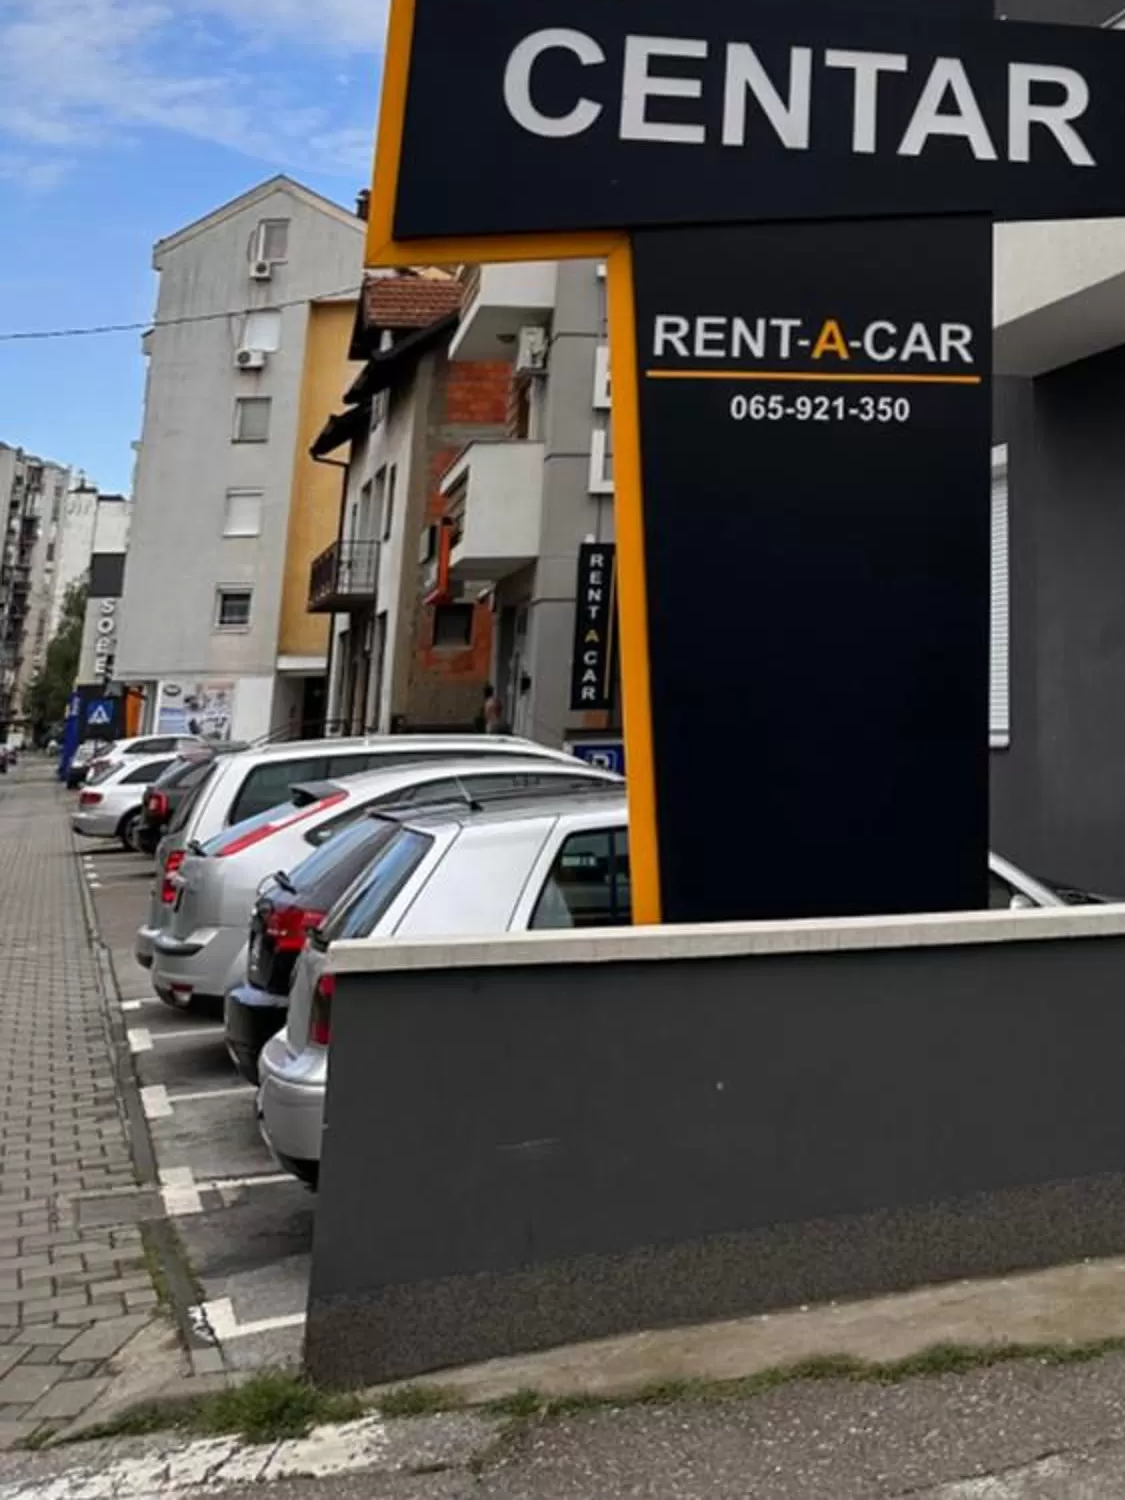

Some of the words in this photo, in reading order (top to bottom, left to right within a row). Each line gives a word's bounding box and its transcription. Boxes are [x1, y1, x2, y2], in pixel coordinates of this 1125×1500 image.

[502, 27, 1097, 168] CENTAR
[652, 314, 975, 363] RENT-A-CAR
[730, 394, 911, 422] 065-921-350
[587, 553, 604, 620] RENT
[584, 628, 600, 643] A
[581, 650, 599, 700] CAR
